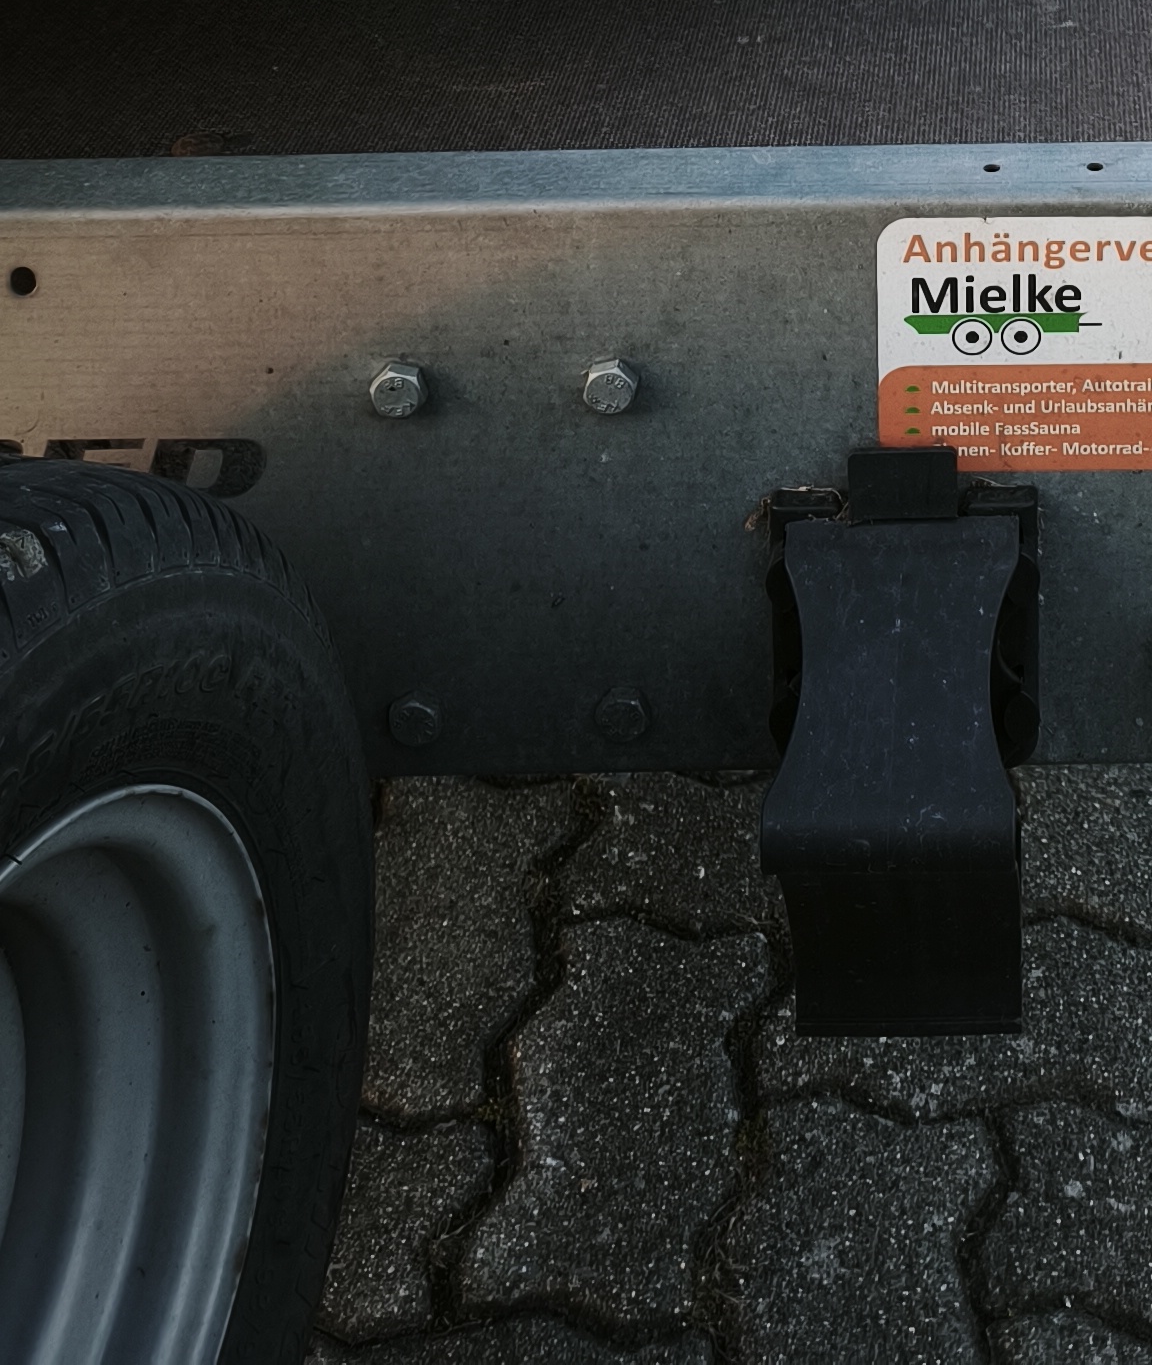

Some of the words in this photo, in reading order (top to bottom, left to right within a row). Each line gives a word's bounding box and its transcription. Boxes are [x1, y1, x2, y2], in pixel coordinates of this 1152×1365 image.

[911, 273, 1082, 313] Mielke
[931, 379, 1077, 396] Multitransporter,
[930, 400, 999, 415] Absenk-
[1003, 399, 1035, 414] und
[931, 422, 990, 437] mobile
[995, 421, 1081, 436] FassSauna
[1001, 442, 1057, 456] Koffer-
[1062, 441, 1149, 455] Motorrad-
